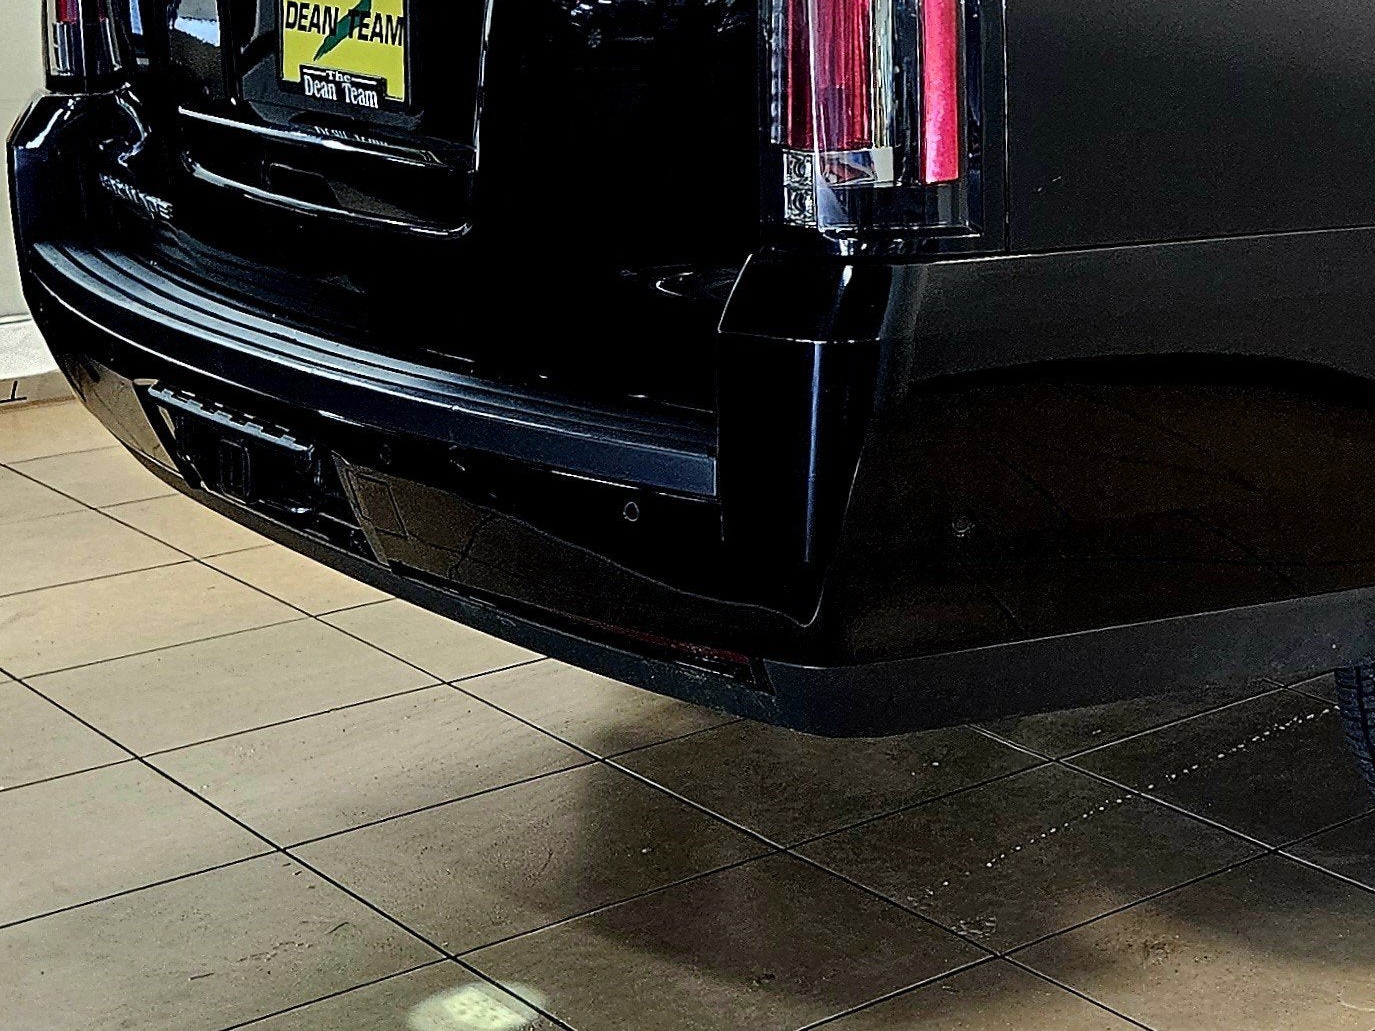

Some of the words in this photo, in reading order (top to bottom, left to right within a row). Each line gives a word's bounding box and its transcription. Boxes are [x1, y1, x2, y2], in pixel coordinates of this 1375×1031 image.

[285, 0, 340, 37] DEAN
[348, 9, 405, 47] TEAM
[303, 74, 337, 101] Dean
[341, 82, 379, 109] Team
[325, 70, 352, 83] The
